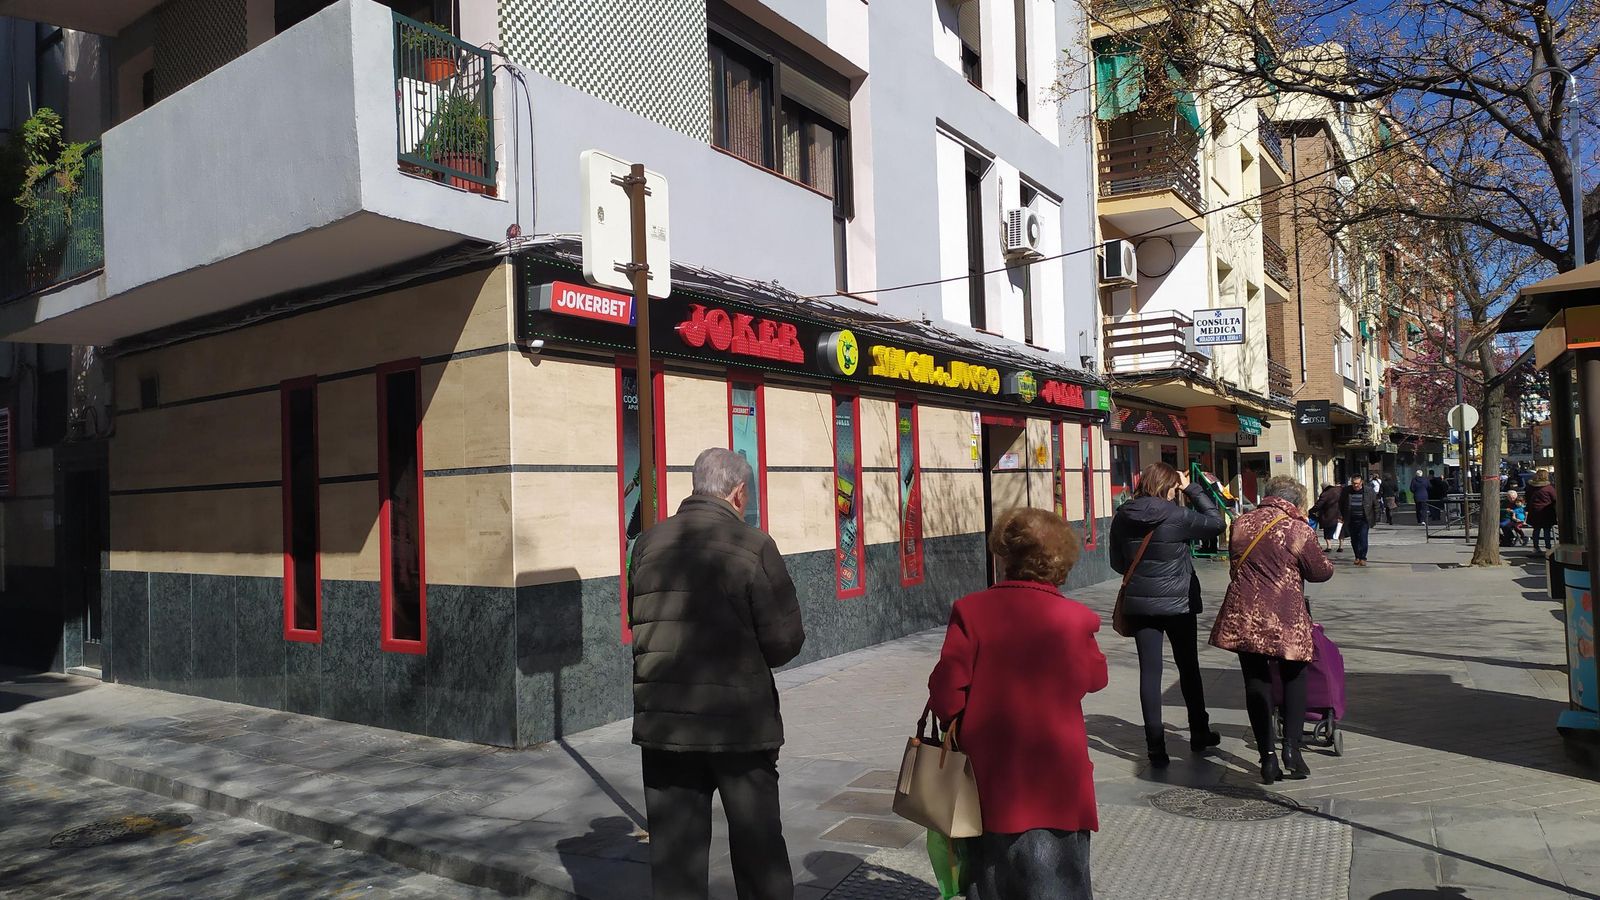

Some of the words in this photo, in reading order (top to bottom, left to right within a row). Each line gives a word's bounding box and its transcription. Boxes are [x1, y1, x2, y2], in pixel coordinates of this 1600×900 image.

[557, 289, 626, 317] JOKERBET
[1196, 317, 1241, 327] CONSULTA
[1200, 326, 1237, 335] MEDICA
[678, 303, 805, 364] JOKER
